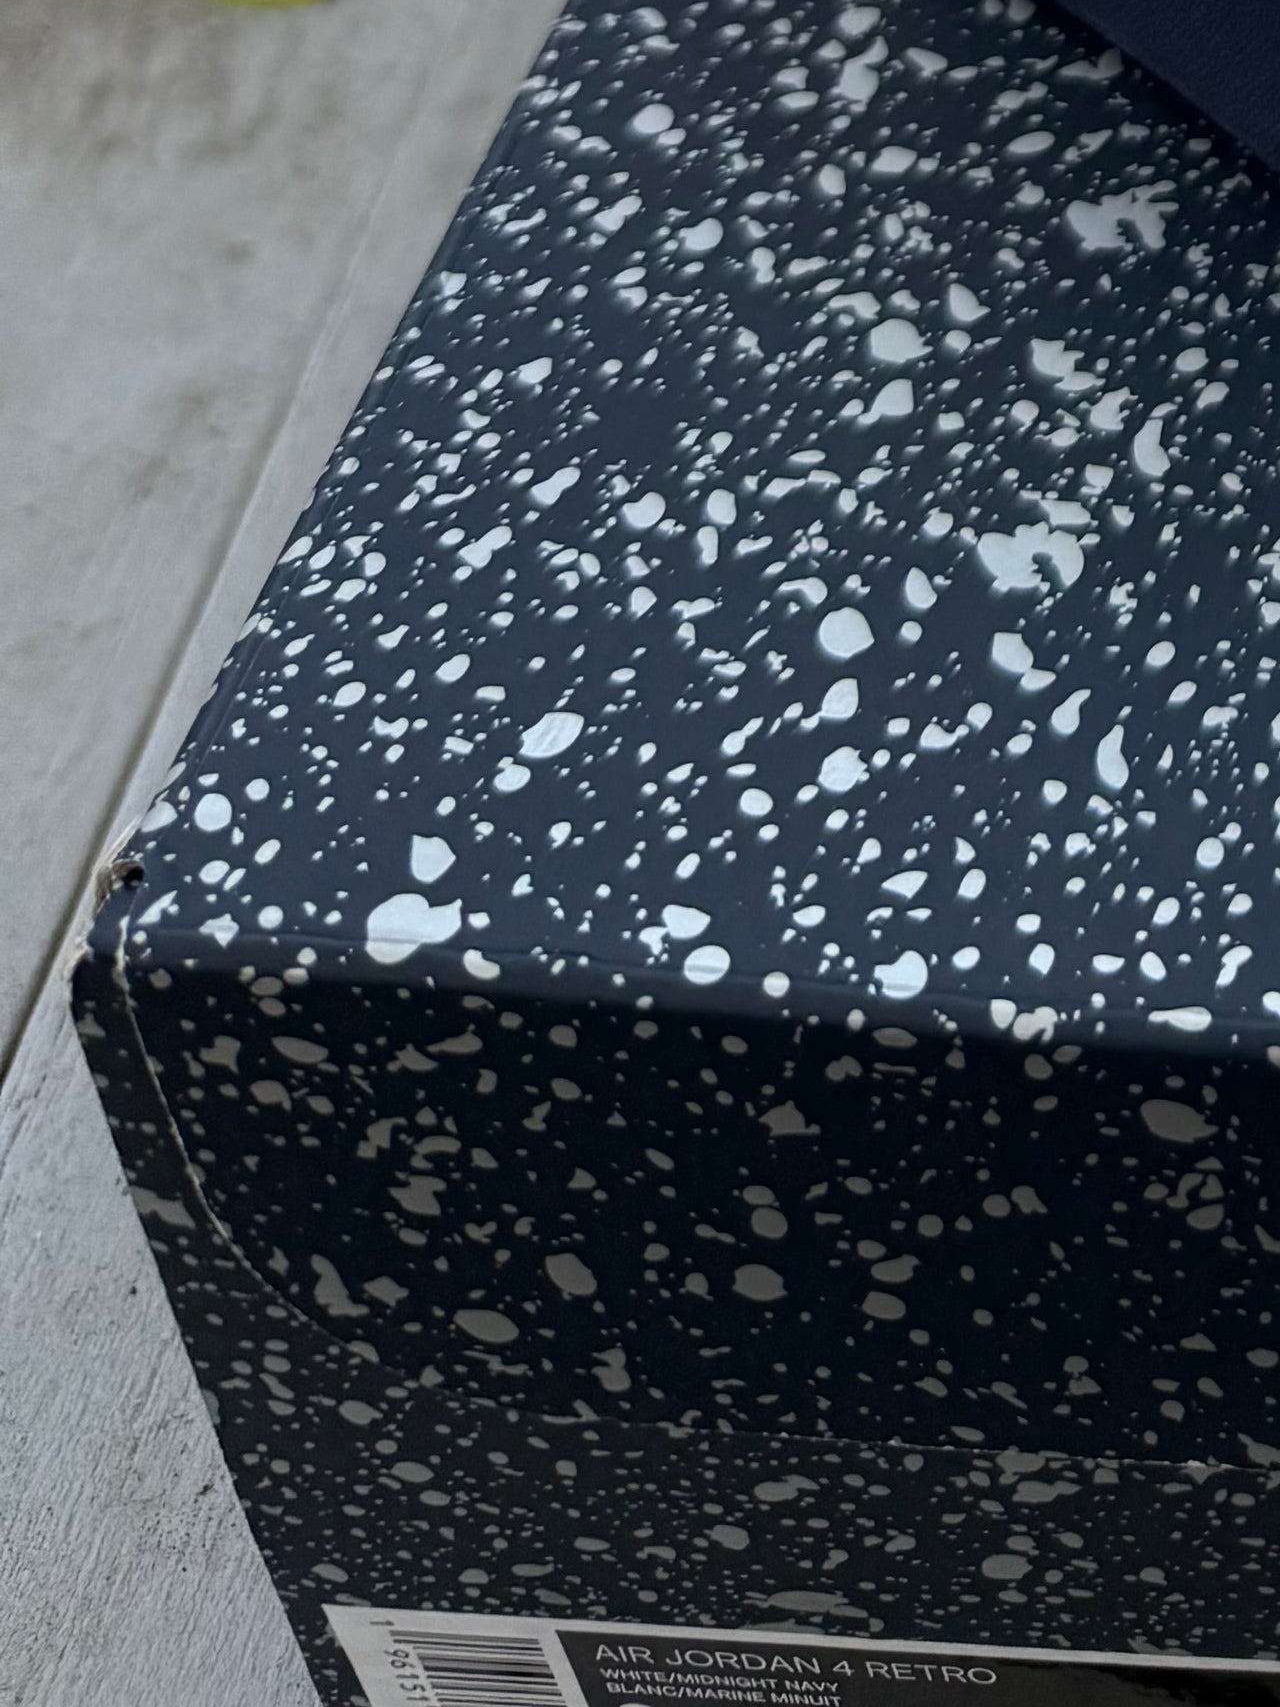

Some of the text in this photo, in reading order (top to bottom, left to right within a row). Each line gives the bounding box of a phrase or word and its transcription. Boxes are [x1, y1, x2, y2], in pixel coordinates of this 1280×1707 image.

[595, 1643, 997, 1685] AIR JORDAN 4 RETRO
[600, 1667, 839, 1693] WHITE/MIDNIGHT NAVY
[606, 1681, 842, 1707] BLANC/MARINE MINUIT
